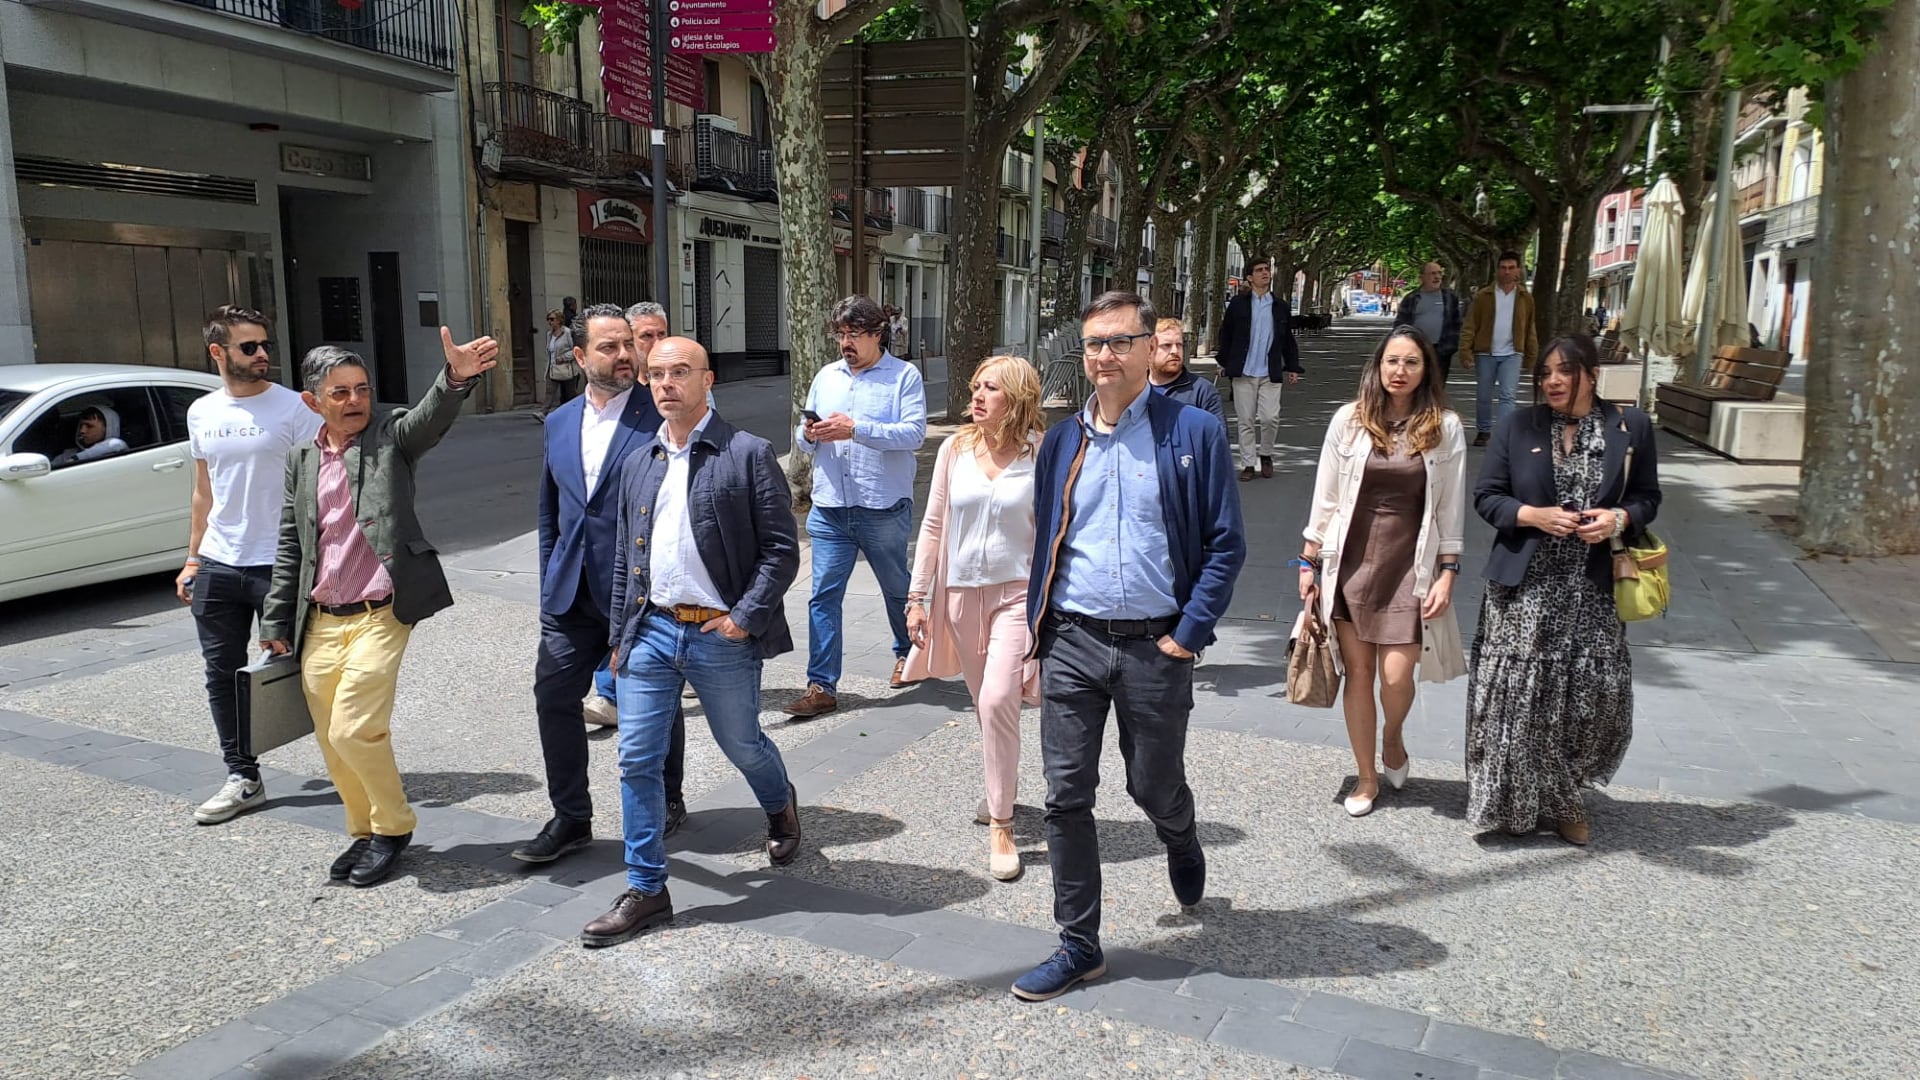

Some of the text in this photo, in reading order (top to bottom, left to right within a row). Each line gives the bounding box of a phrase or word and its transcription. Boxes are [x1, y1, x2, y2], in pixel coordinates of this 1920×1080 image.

[681, 1, 727, 10] Ayuntamiento
[703, 16, 721, 25] Local
[681, 33, 724, 42] Iglesia de los
[681, 41, 741, 50] Padres Escolapios
